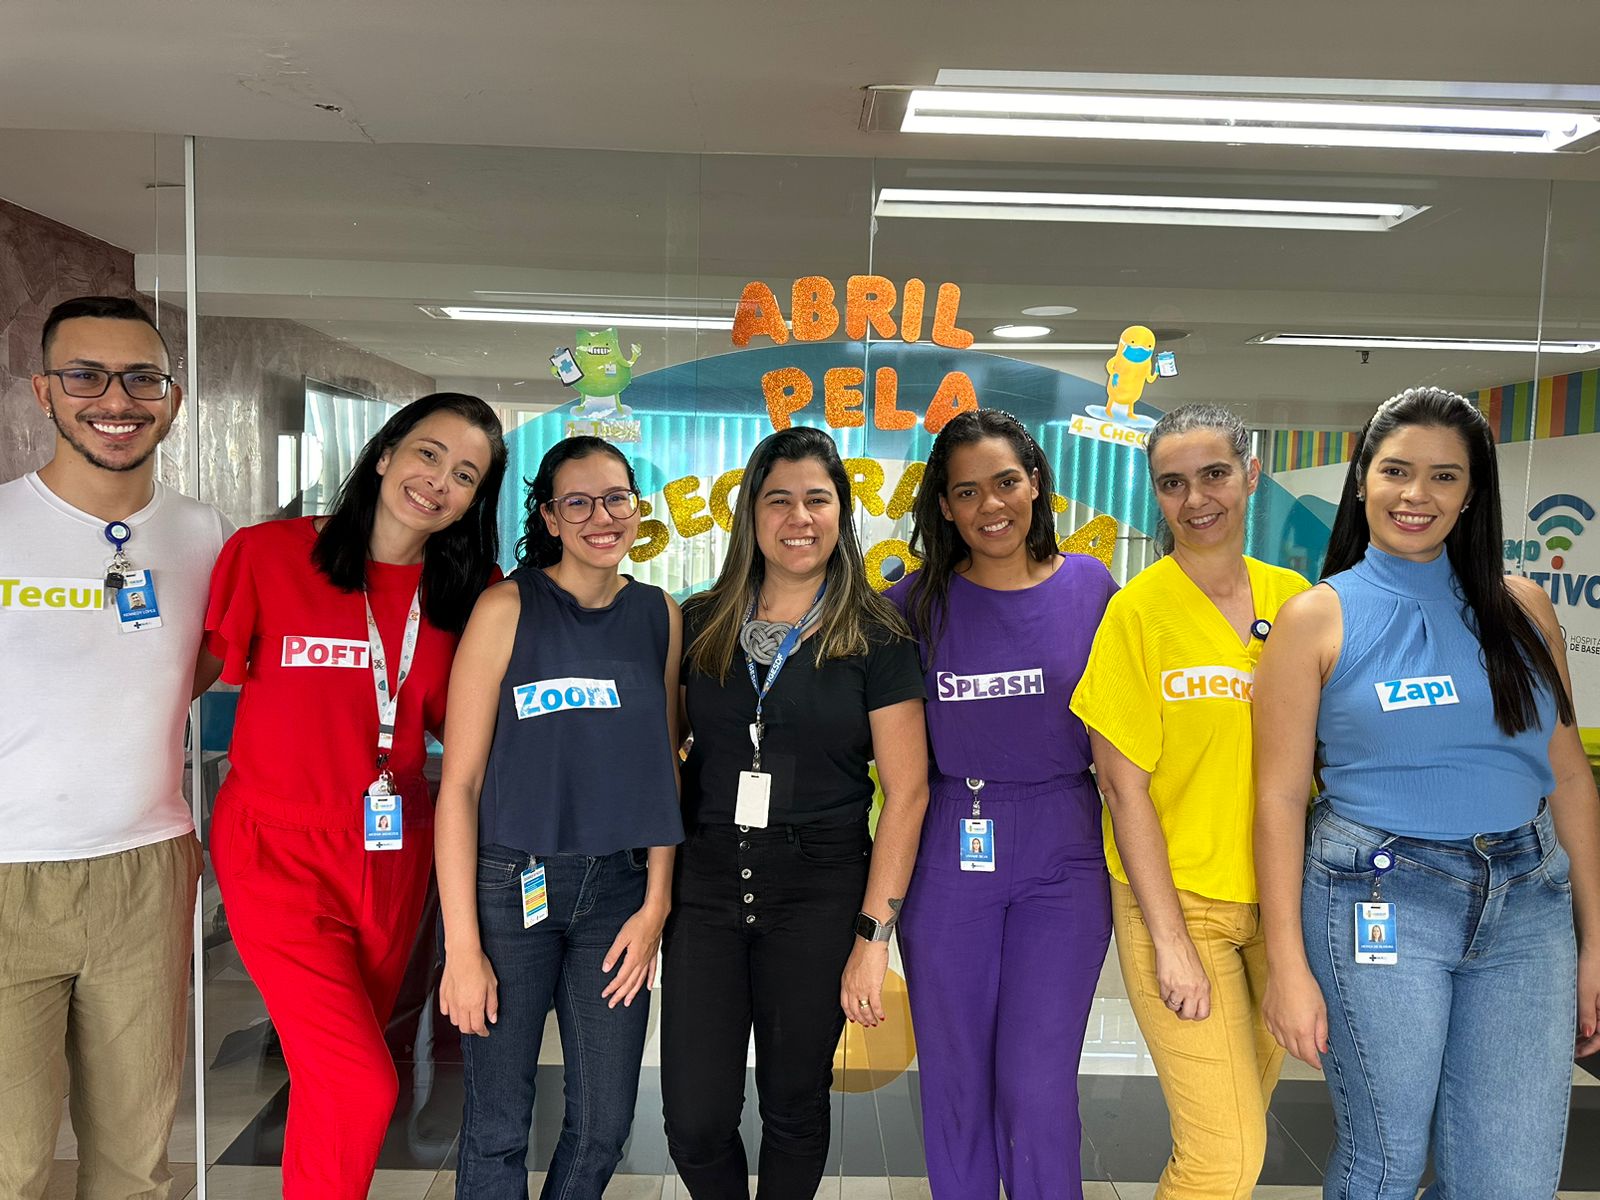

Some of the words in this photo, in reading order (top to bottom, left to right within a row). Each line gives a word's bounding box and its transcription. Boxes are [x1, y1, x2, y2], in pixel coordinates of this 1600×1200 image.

[731, 275, 975, 349] ABRIL
[761, 366, 979, 435] PELA
[767, 652, 784, 683] IGESDF
[1570, 643, 1580, 653] DE
